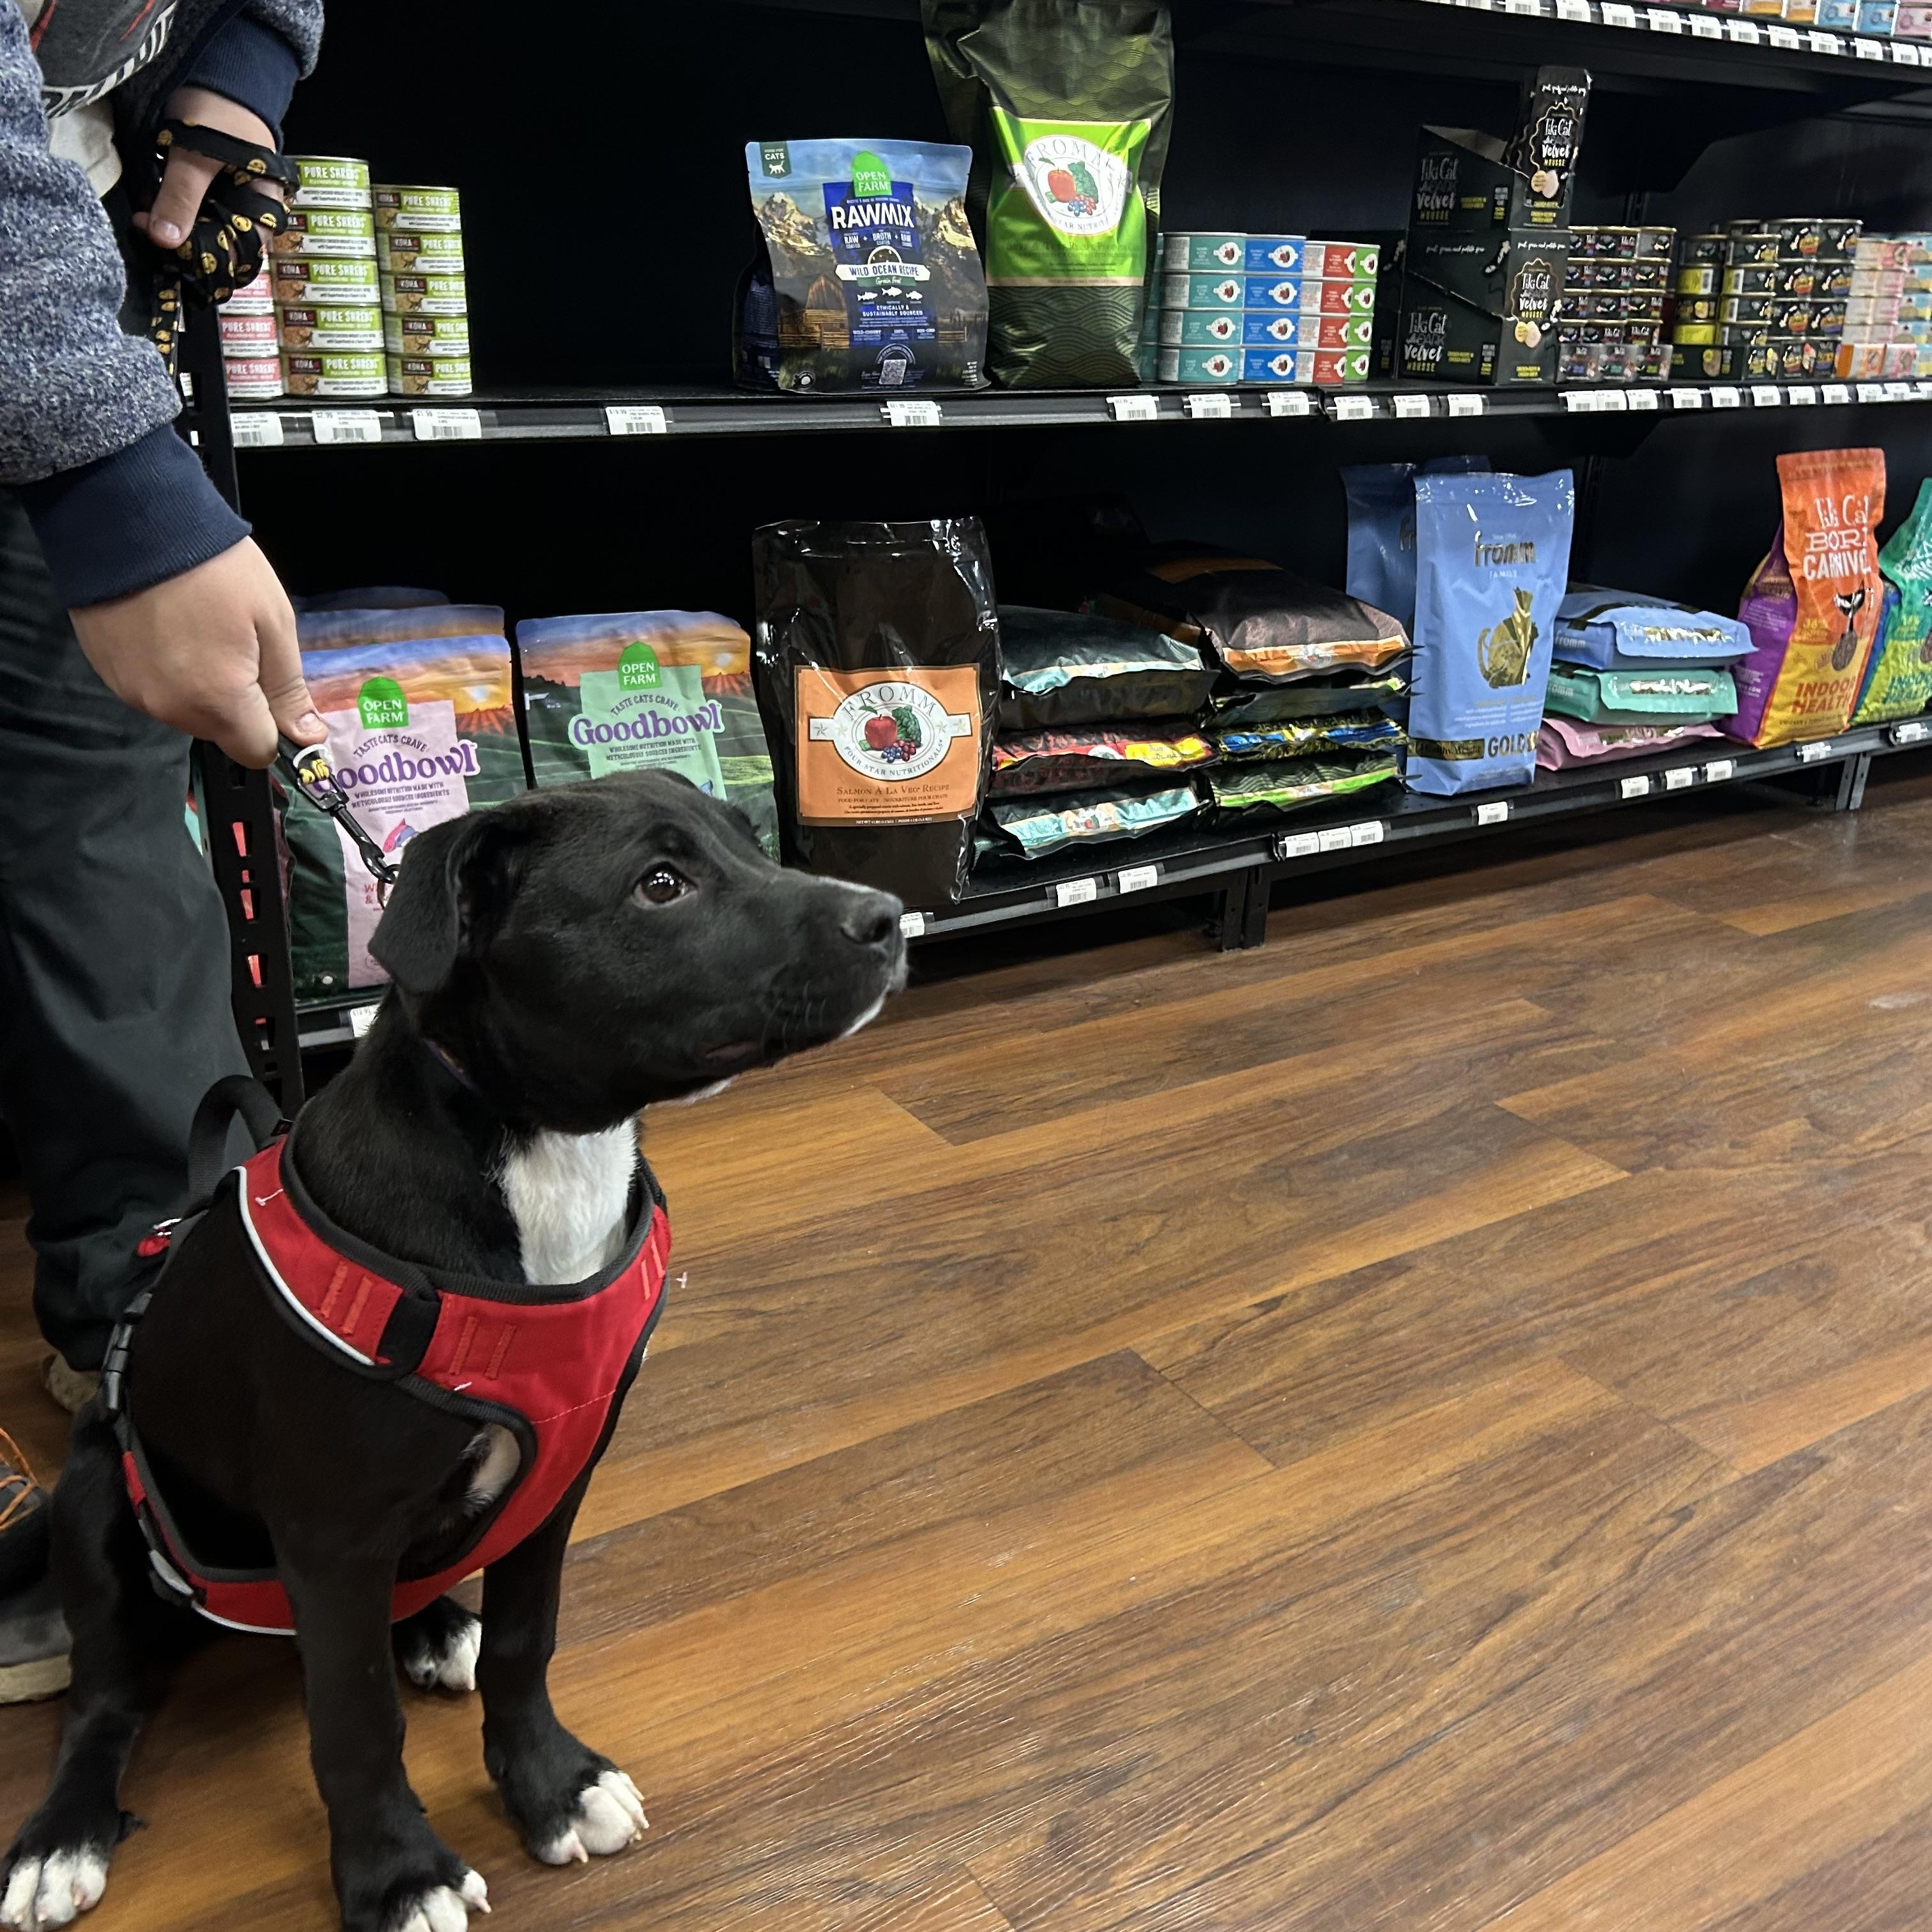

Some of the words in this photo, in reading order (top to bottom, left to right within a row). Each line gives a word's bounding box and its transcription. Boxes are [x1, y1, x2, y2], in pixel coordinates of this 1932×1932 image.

[1542, 144, 1570, 158] Velvet
[304, 167, 328, 178] PURE
[856, 171, 886, 181] OPEN
[858, 181, 889, 192] FARM
[310, 215, 334, 227] PURE
[831, 203, 915, 229] RAWMIX
[844, 235, 859, 244] RAW
[872, 232, 891, 241] BROTH
[312, 264, 336, 275] PURE
[849, 266, 869, 276] WILD
[873, 264, 897, 275] OCEAN
[899, 265, 919, 275] RECIPE
[1519, 298, 1547, 310] Velvet
[321, 311, 342, 322] PURE
[1404, 344, 1443, 362] Velvet
[326, 358, 348, 369] PURE
[1475, 531, 1535, 567] fromm
[1555, 630, 1586, 648] fromm
[622, 662, 655, 674] OPEN
[624, 673, 656, 686] FARM
[1548, 684, 1574, 697] romm
[363, 699, 402, 712] OPEN
[611, 698, 633, 716] TASTE
[633, 694, 653, 703] CATS
[656, 695, 679, 710] CRAVE
[841, 685, 936, 720] FROMM
[366, 711, 403, 724] FARM
[574, 703, 721, 745] Goodbowl
[353, 736, 378, 758] TASTE
[379, 734, 398, 744] CATS
[401, 735, 427, 752] CRAVE
[844, 746, 862, 766] FOUR
[864, 765, 886, 776] STAR
